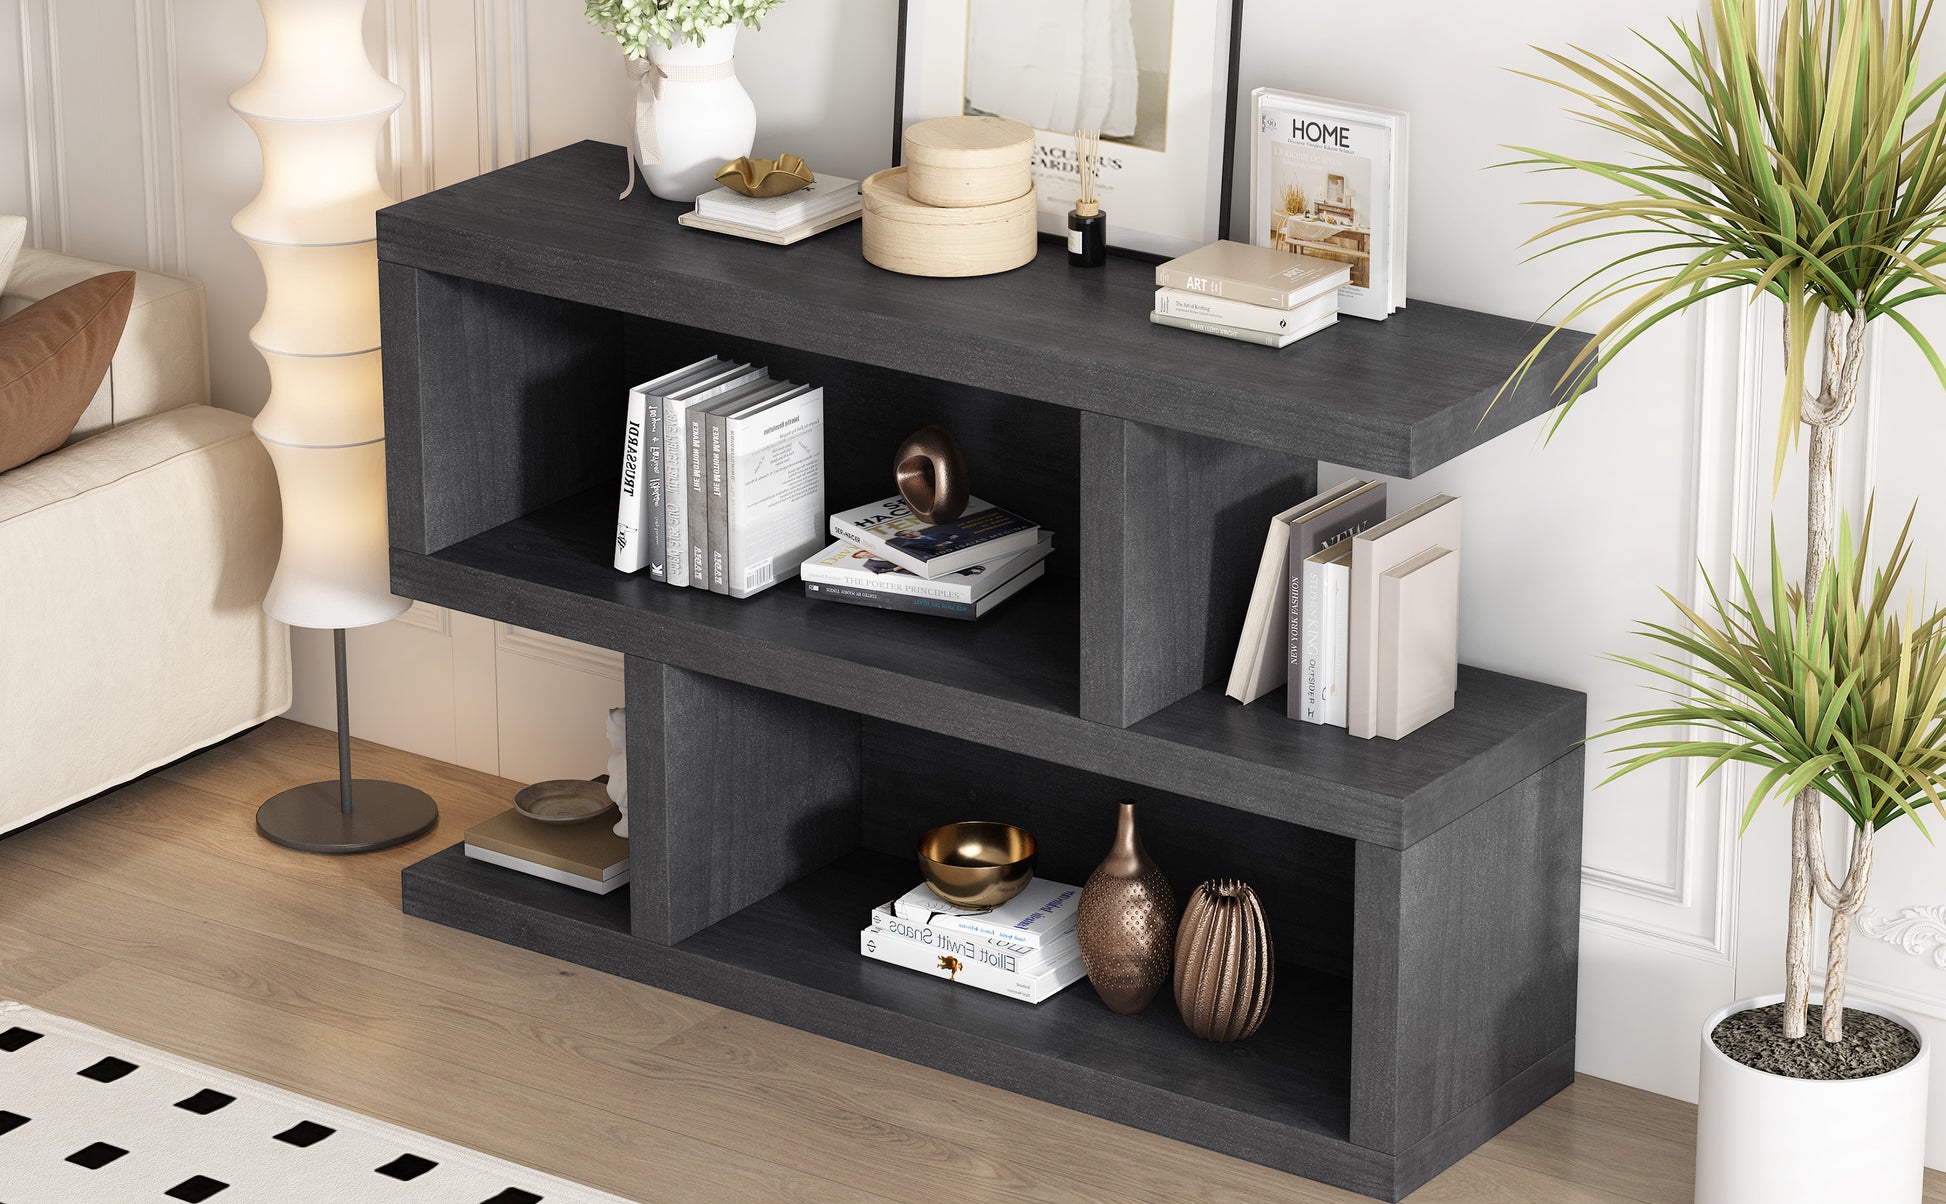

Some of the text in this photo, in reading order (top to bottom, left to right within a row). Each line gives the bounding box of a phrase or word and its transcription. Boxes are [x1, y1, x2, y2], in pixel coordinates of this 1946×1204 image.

[1292, 118, 1350, 148] HOME
[1186, 276, 1208, 292] ART
[844, 576, 863, 586] THE
[866, 579, 903, 592] PORTER
[905, 584, 960, 599] PRINCIPLES
[1291, 576, 1299, 615] FASHION
[1307, 619, 1320, 656] KING
[1308, 659, 1317, 704] OUTSIDER
